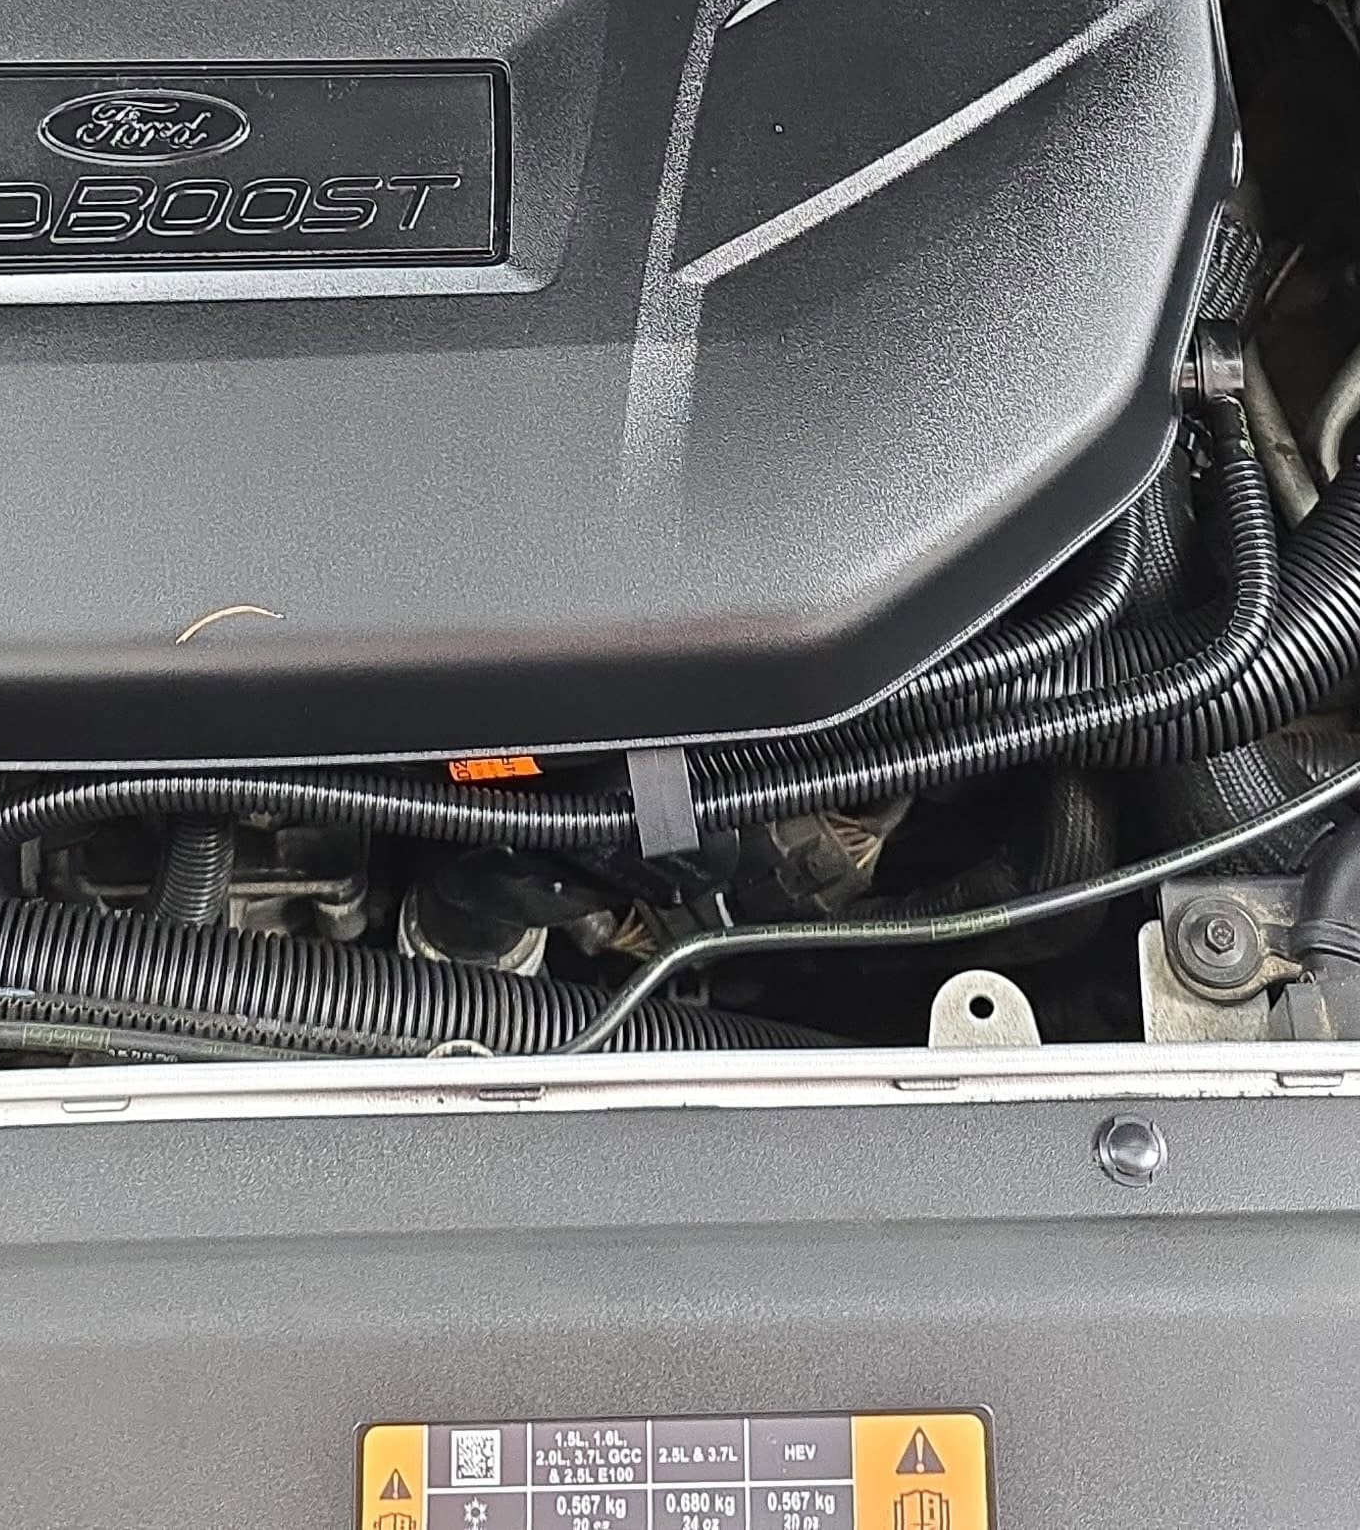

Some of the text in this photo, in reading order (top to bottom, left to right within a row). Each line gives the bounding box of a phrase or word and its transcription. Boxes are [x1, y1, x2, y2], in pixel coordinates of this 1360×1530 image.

[74, 98, 213, 150] Ford
[535, 1448, 643, 1467] 2.0L, 3.7L GCC
[693, 1447, 705, 1462] &
[707, 1446, 739, 1462] 3.7L
[784, 1444, 818, 1461] HEV
[548, 1468, 560, 1484] &
[598, 1466, 634, 1483] E100
[556, 1495, 627, 1518] 0.567 kg
[666, 1493, 736, 1516] 0.680 kg
[767, 1491, 836, 1514] 0.567 kg
